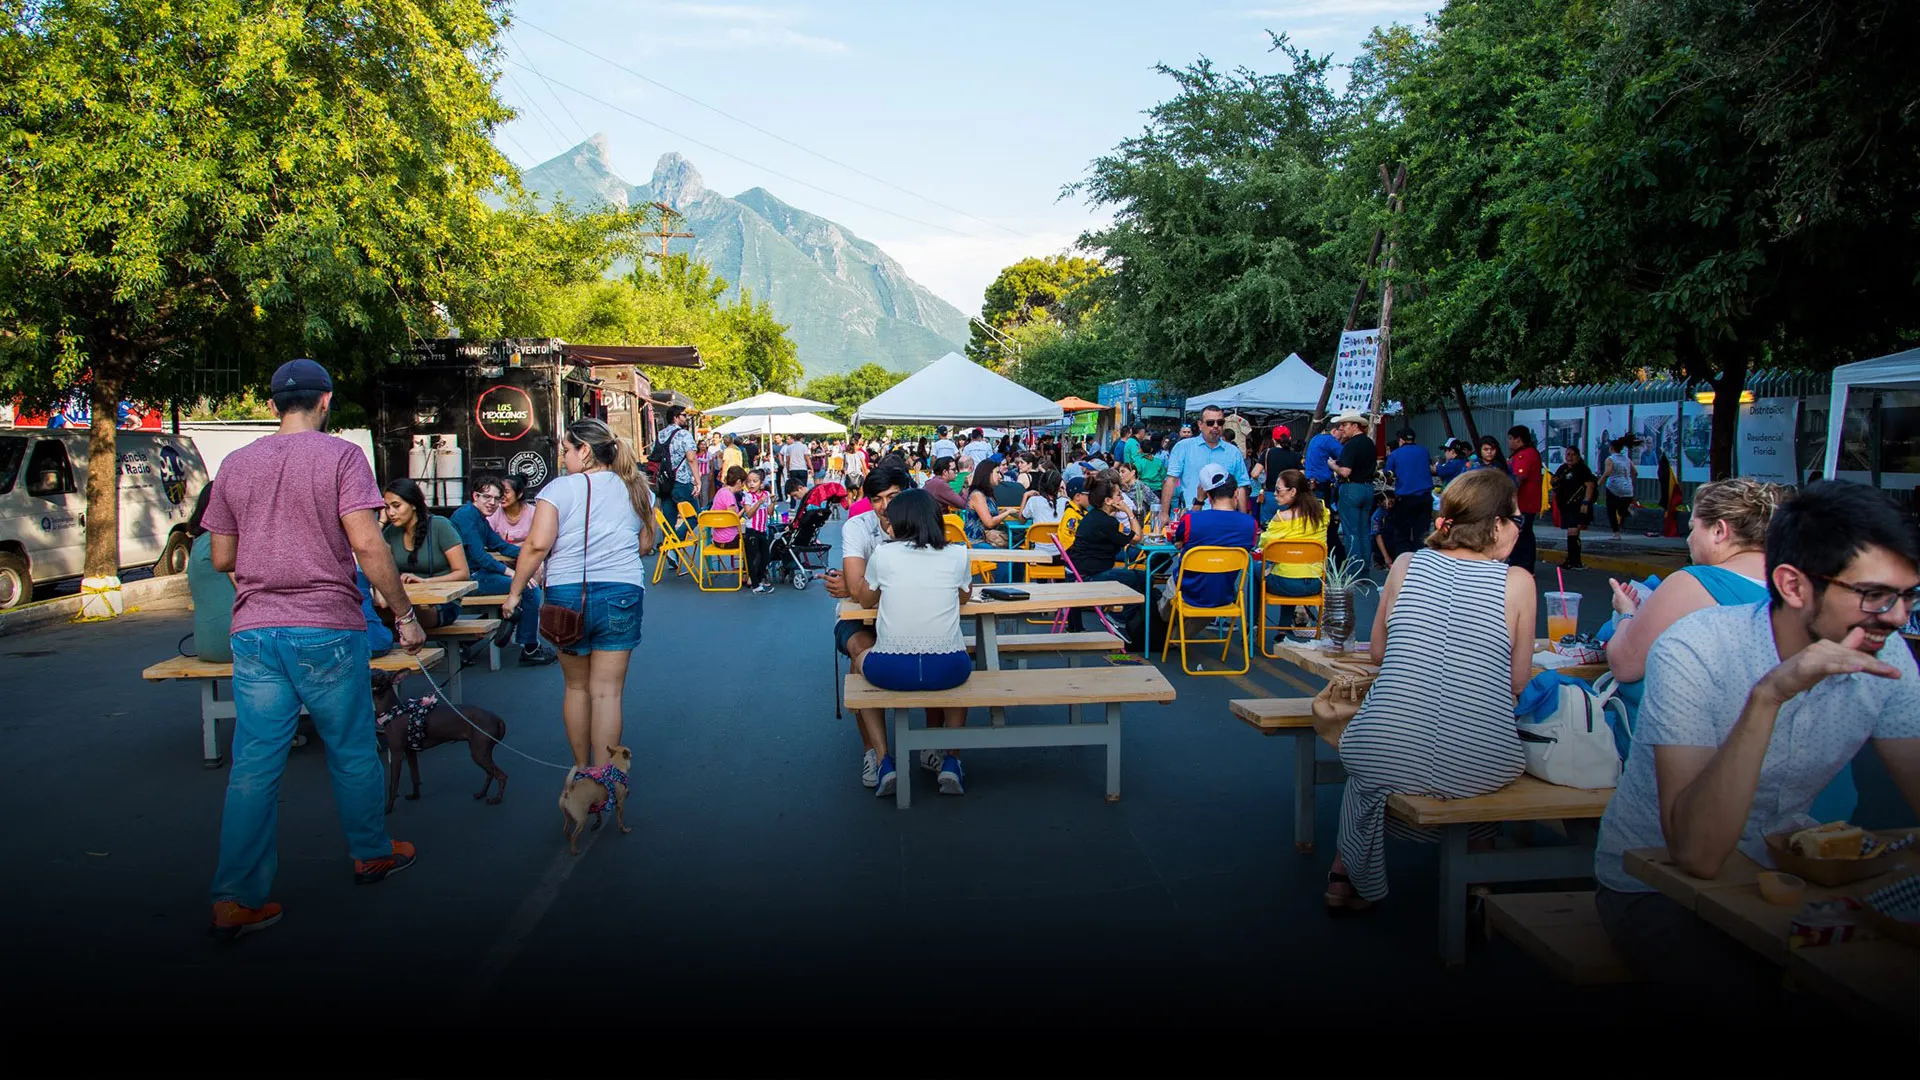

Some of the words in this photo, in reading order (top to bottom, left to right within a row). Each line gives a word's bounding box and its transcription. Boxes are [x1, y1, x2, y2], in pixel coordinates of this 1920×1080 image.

[1747, 432, 1784, 442] Residencial
[1753, 446, 1776, 456] Florida
[125, 463, 151, 475] Radio
